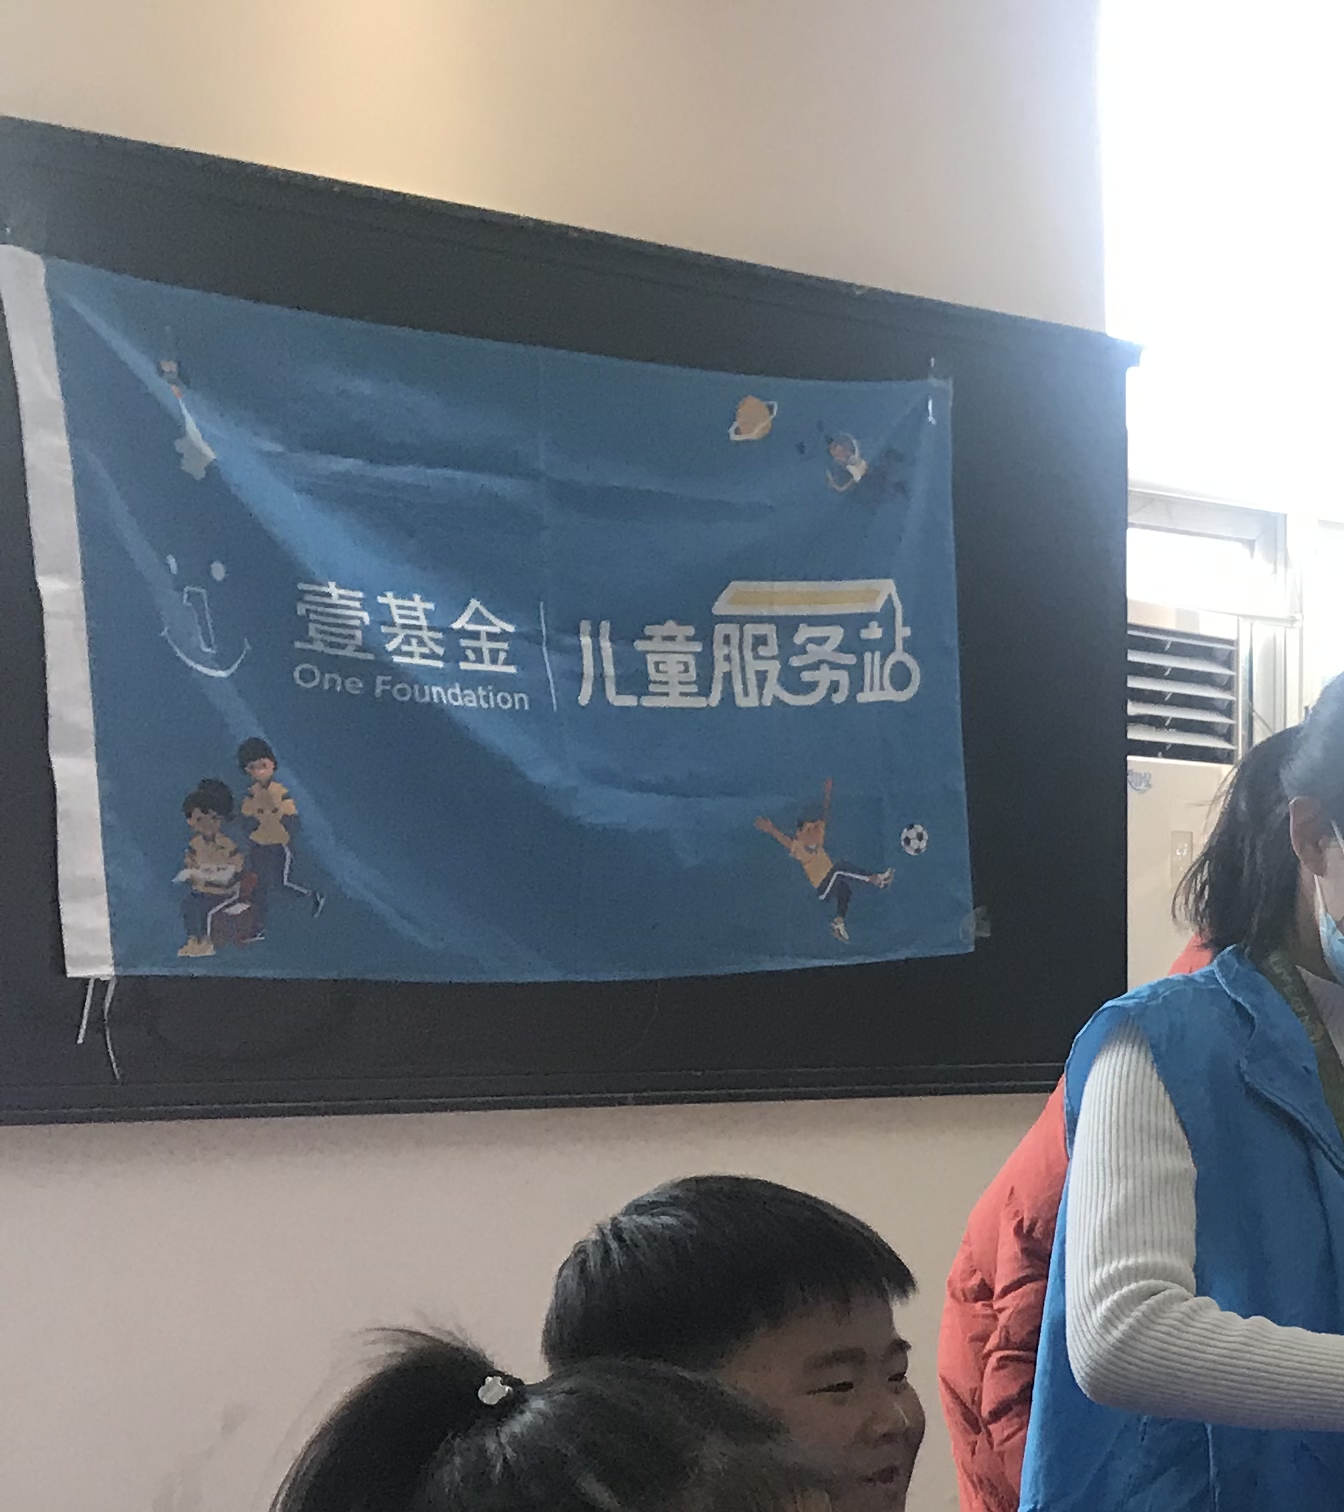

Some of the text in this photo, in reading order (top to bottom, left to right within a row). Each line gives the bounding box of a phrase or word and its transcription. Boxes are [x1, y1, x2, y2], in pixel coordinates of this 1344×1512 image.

[293, 581, 518, 674] 壹基金
[577, 590, 921, 708] 儿童服务站
[293, 663, 530, 711] One Foundation
